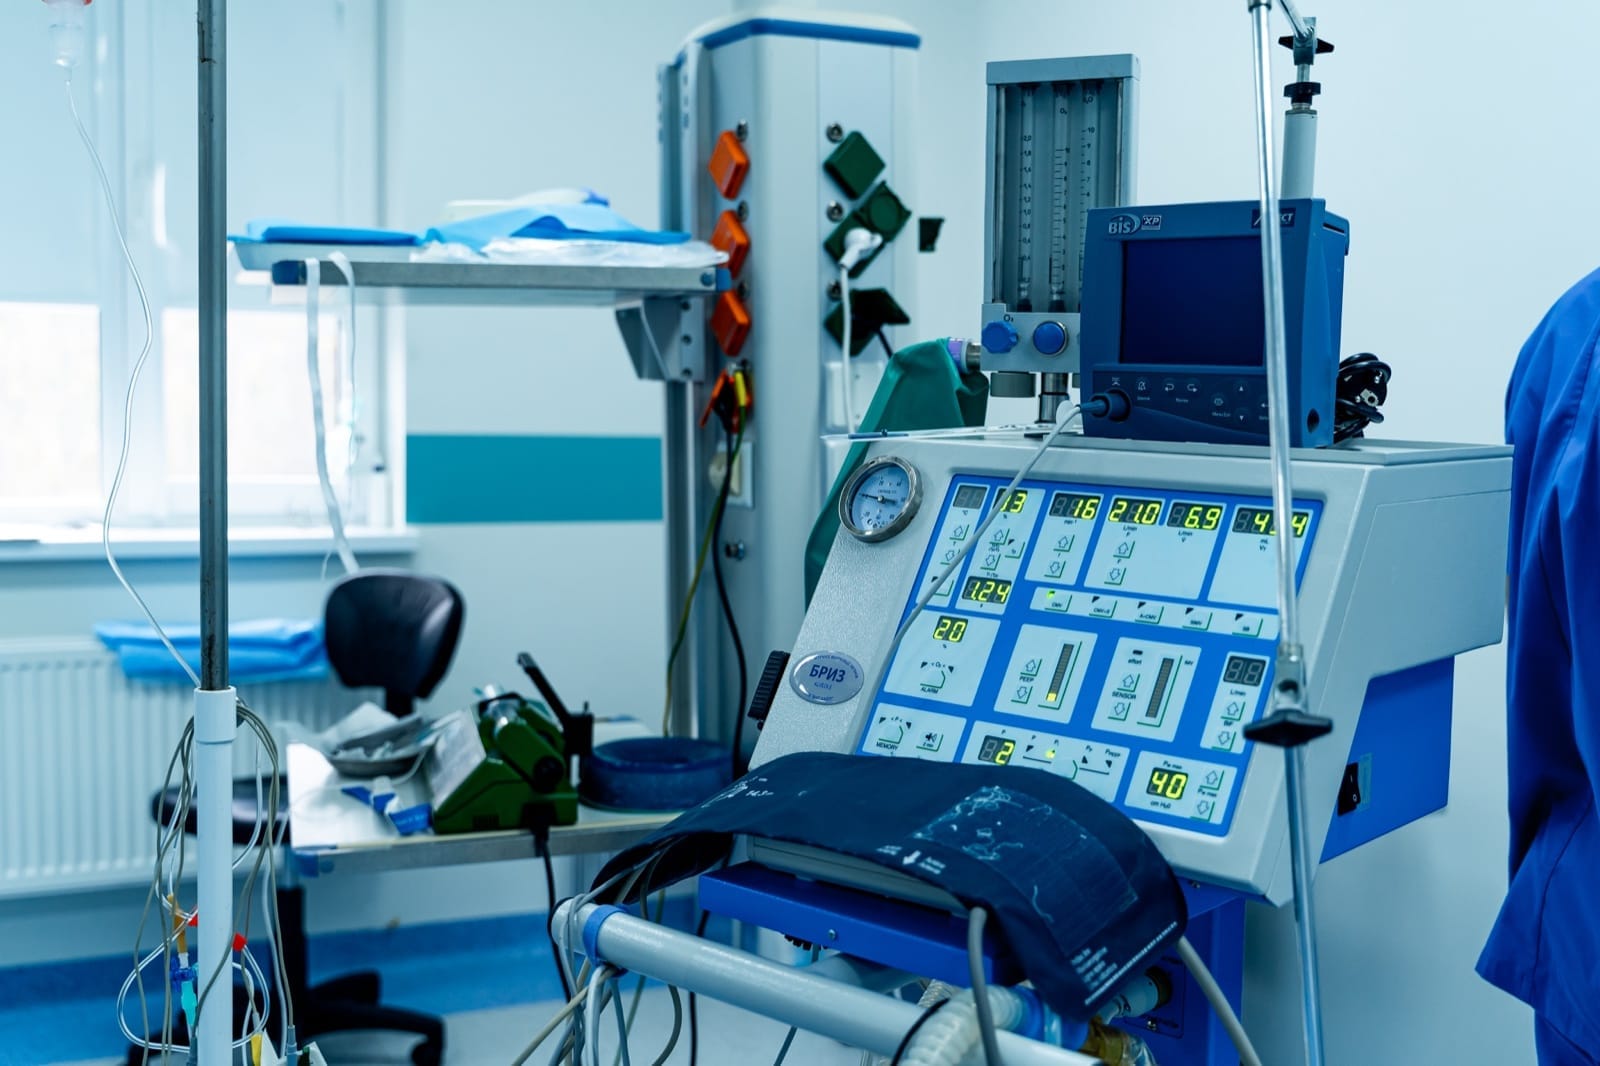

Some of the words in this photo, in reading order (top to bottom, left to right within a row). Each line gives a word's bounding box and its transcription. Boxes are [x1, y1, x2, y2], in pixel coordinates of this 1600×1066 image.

[1074, 499, 1099, 519] 16
[1109, 501, 1160, 525] 21.0
[1184, 507, 1221, 530] 6.9
[1254, 513, 1307, 535] 44
[971, 581, 1011, 602] 1.24
[933, 619, 966, 642] 20
[809, 664, 846, 682] БРИЗ
[1019, 675, 1034, 683] PEEP
[1112, 691, 1136, 700] SENSOR
[876, 742, 899, 751] MEMORY
[995, 741, 1014, 765] 2
[1152, 771, 1187, 799] 40
